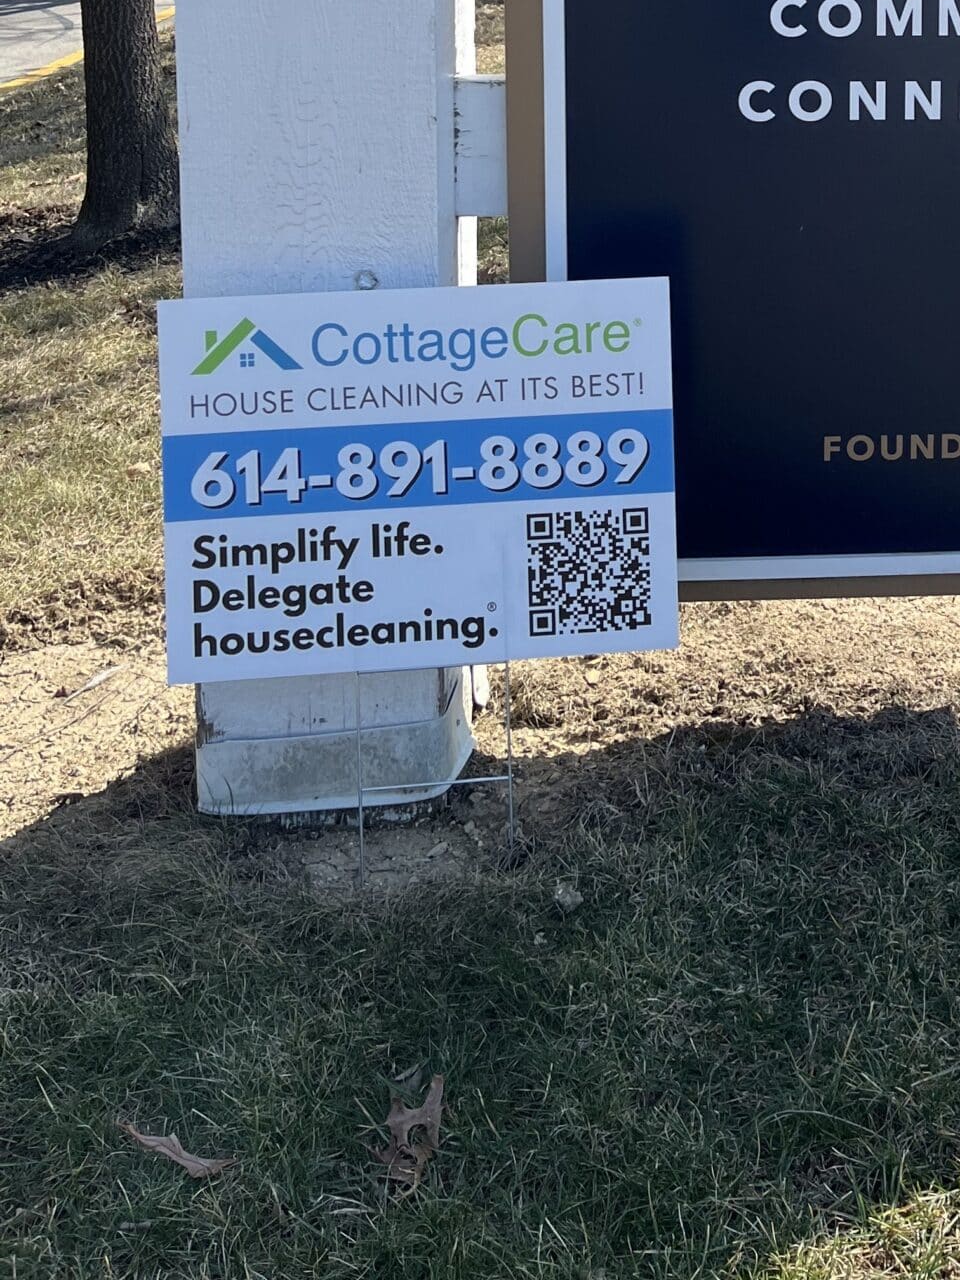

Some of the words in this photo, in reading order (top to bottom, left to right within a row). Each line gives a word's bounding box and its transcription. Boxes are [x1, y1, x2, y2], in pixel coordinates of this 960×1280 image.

[190, 390, 294, 418] HOUSE
[307, 381, 463, 412] CLEANING
[475, 379, 509, 403] AT
[520, 376, 559, 401] ITS
[571, 372, 645, 398] BEST!
[190, 428, 650, 508] 614-891-8889
[191, 524, 361, 574] Simplify
[372, 521, 444, 558] life.
[193, 575, 375, 616] Delegate
